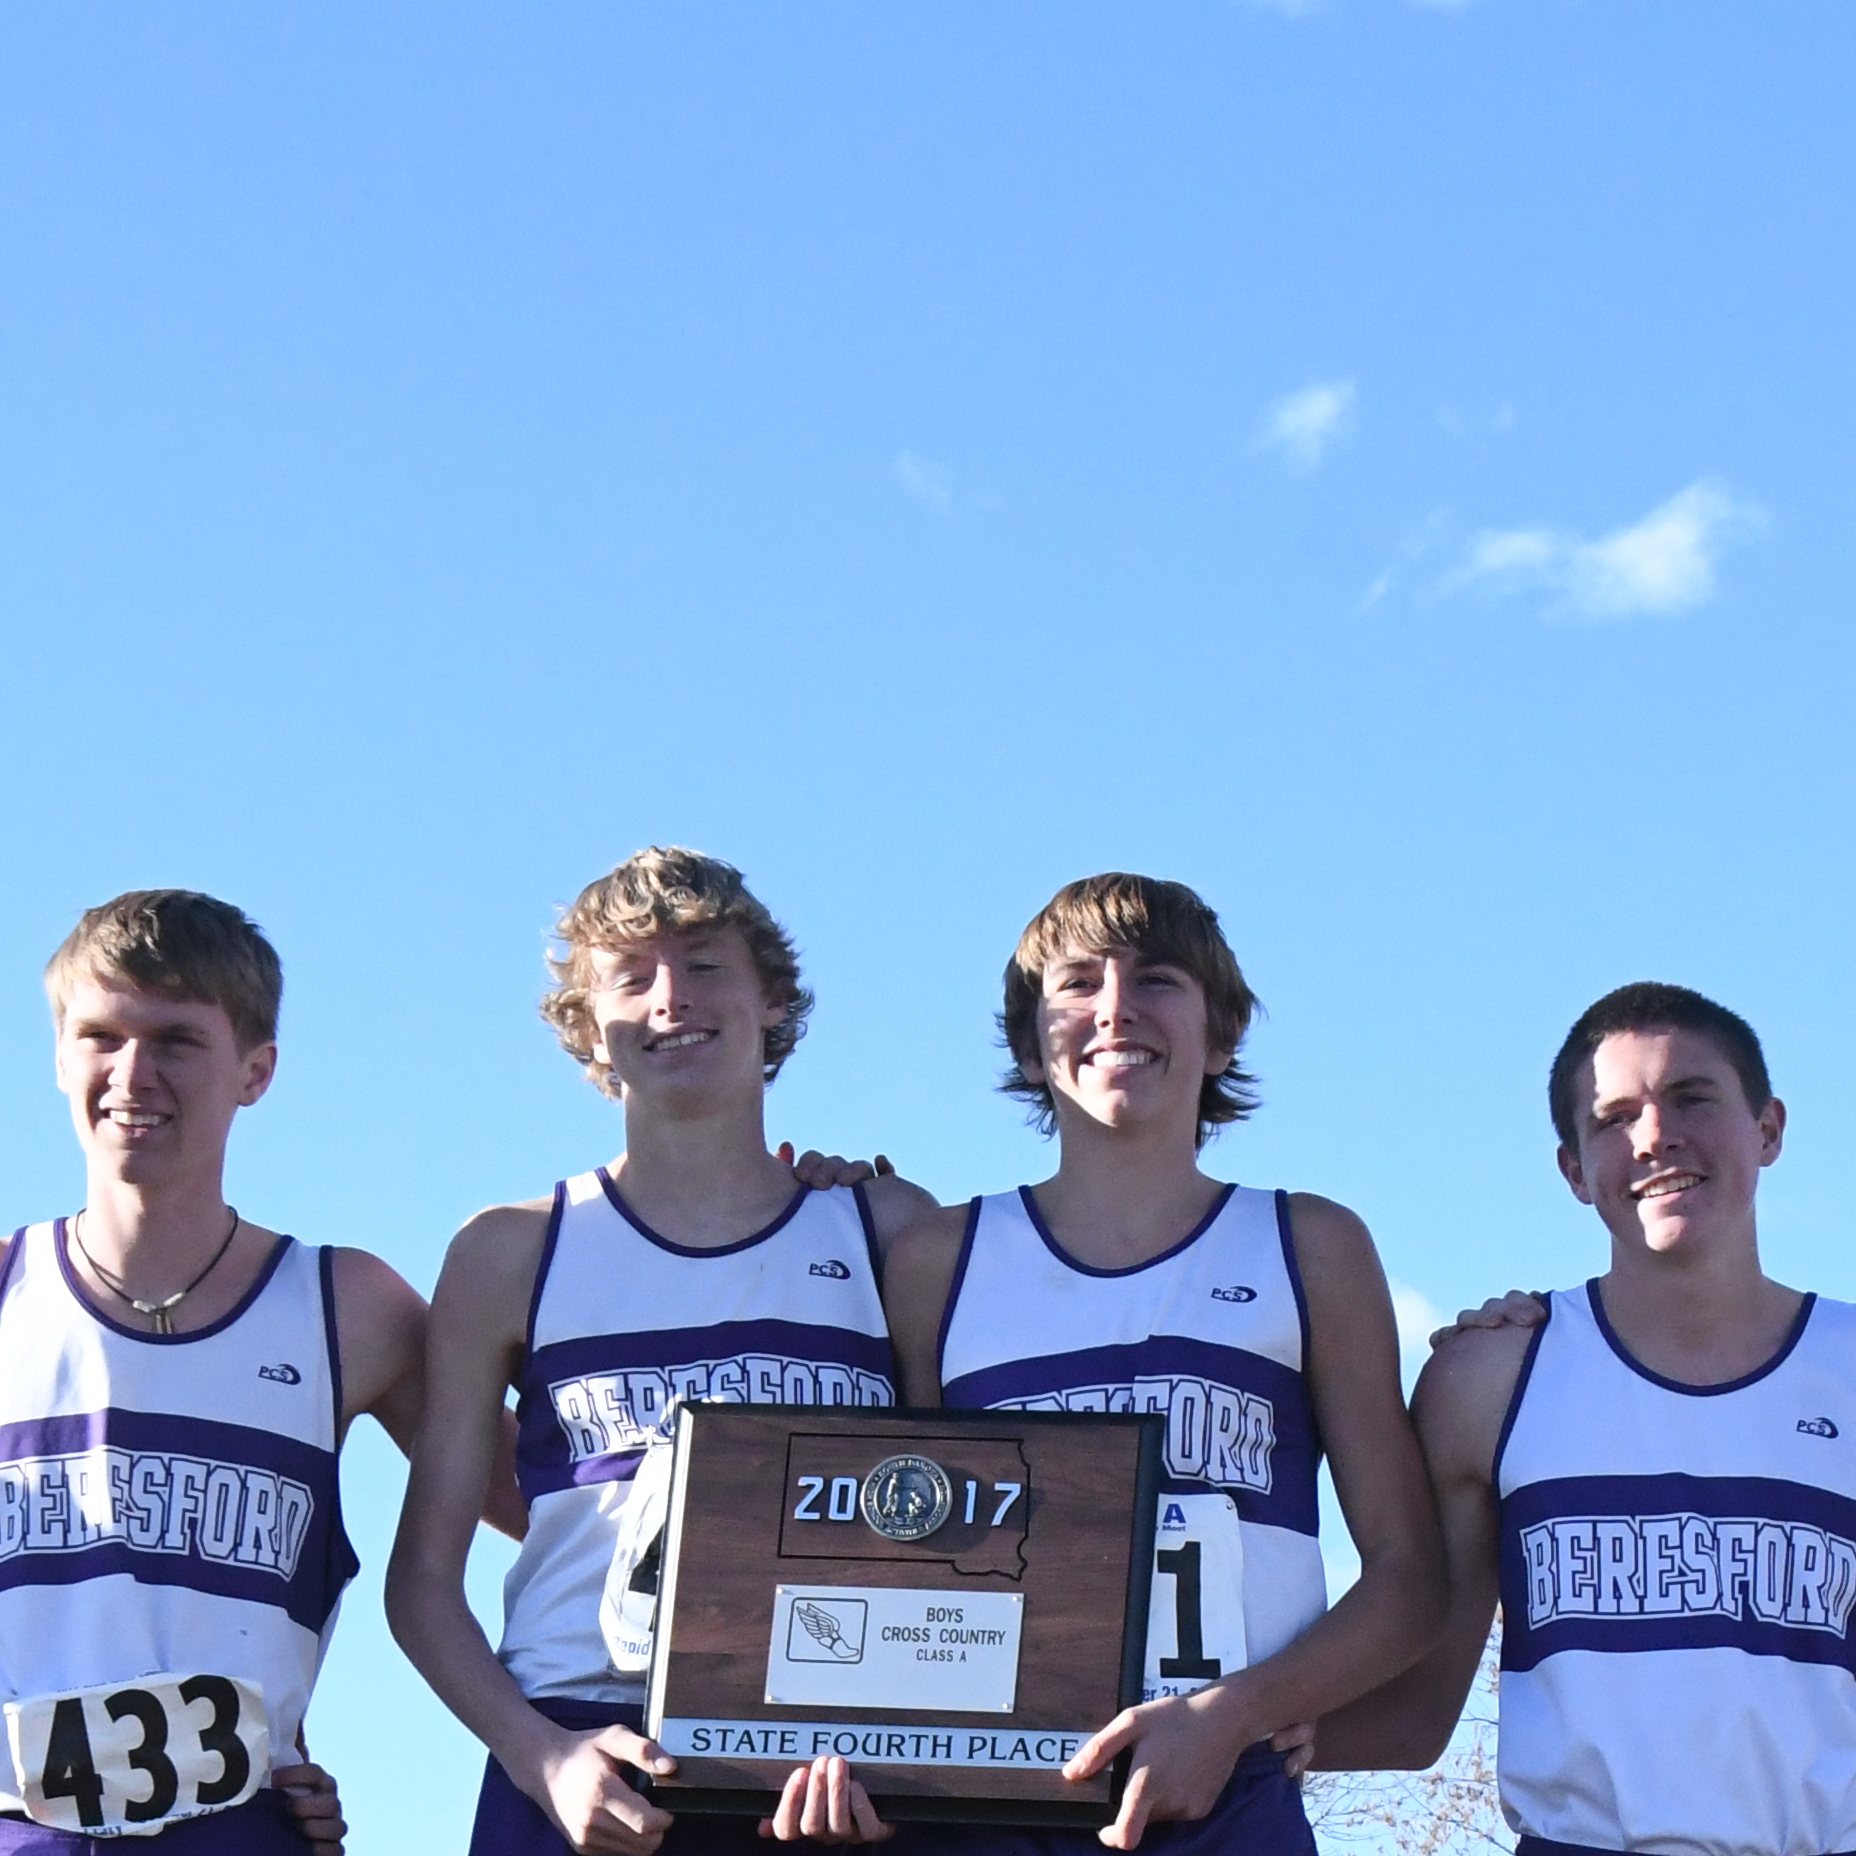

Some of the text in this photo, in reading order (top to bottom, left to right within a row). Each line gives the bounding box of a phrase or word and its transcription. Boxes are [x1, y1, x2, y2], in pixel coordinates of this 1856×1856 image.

[795, 1476, 857, 1520] 20
[965, 1480, 1021, 1526] 17
[926, 1607, 963, 1623] BOYS
[881, 1626, 1006, 1646] CROSS COUNTRY
[916, 1649, 967, 1662] CLASS A
[41, 1674, 250, 1827] 433
[691, 1727, 1080, 1763] STATE FOURTH PLACE
